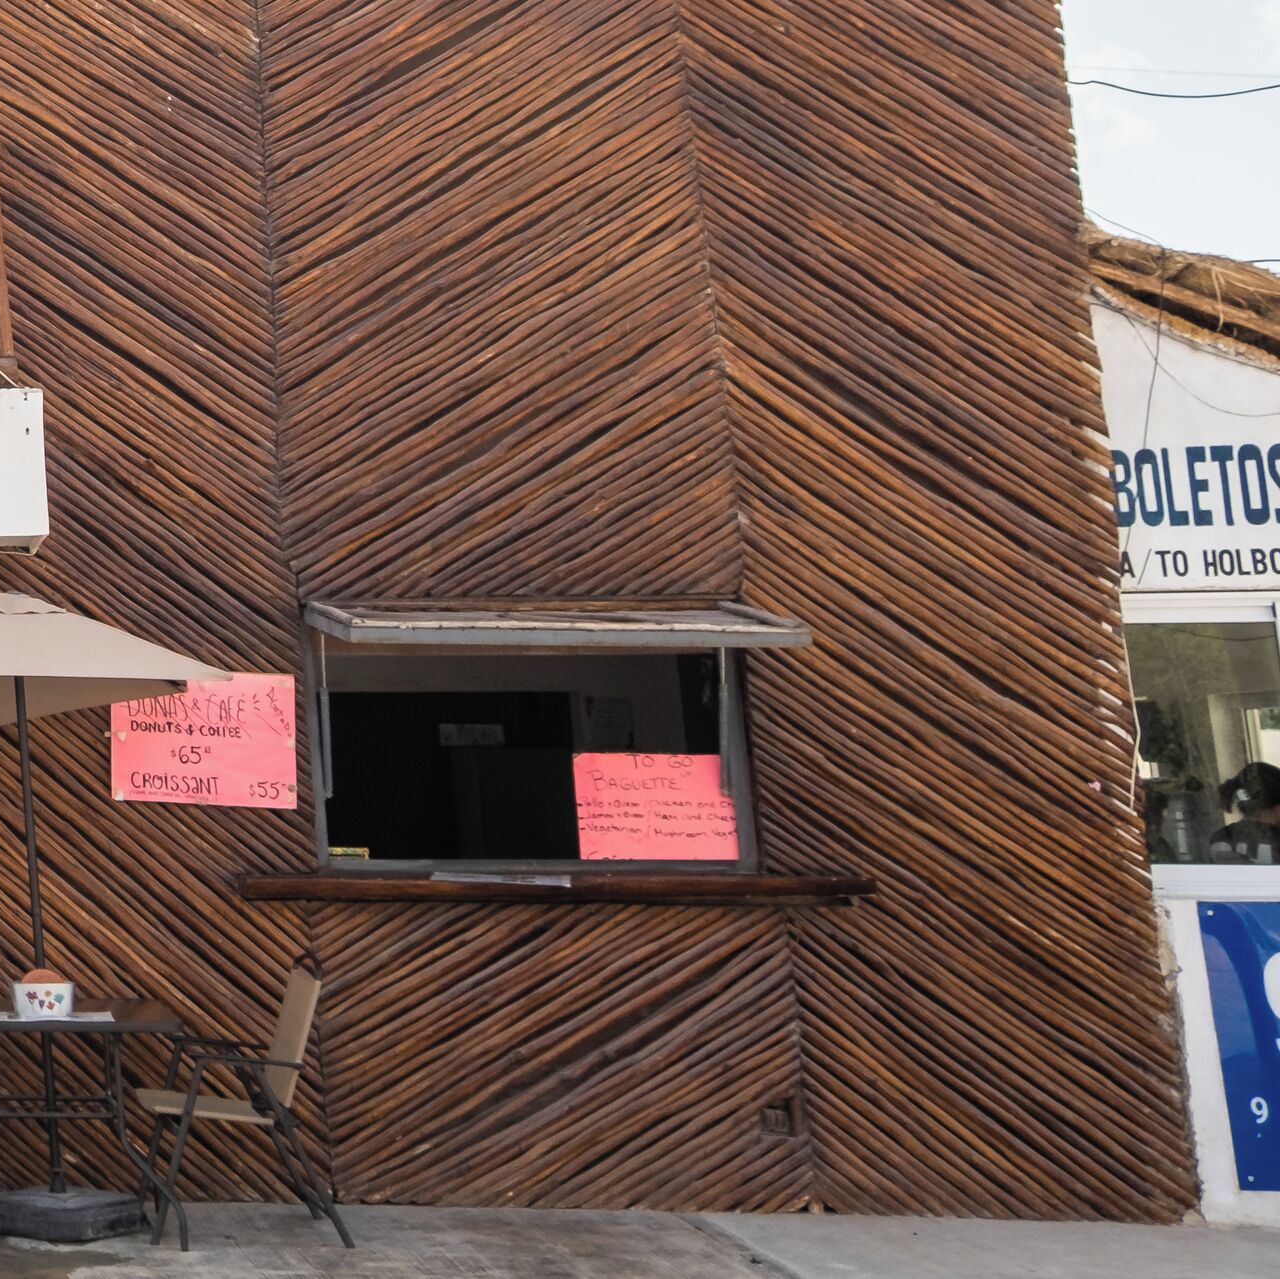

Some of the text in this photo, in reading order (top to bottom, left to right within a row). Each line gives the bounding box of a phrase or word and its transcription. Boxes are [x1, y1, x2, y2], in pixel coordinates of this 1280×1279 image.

[130, 720, 182, 734] DONUTS
[625, 754, 694, 769] TO GO
[586, 769, 683, 792] BAGUETTE
